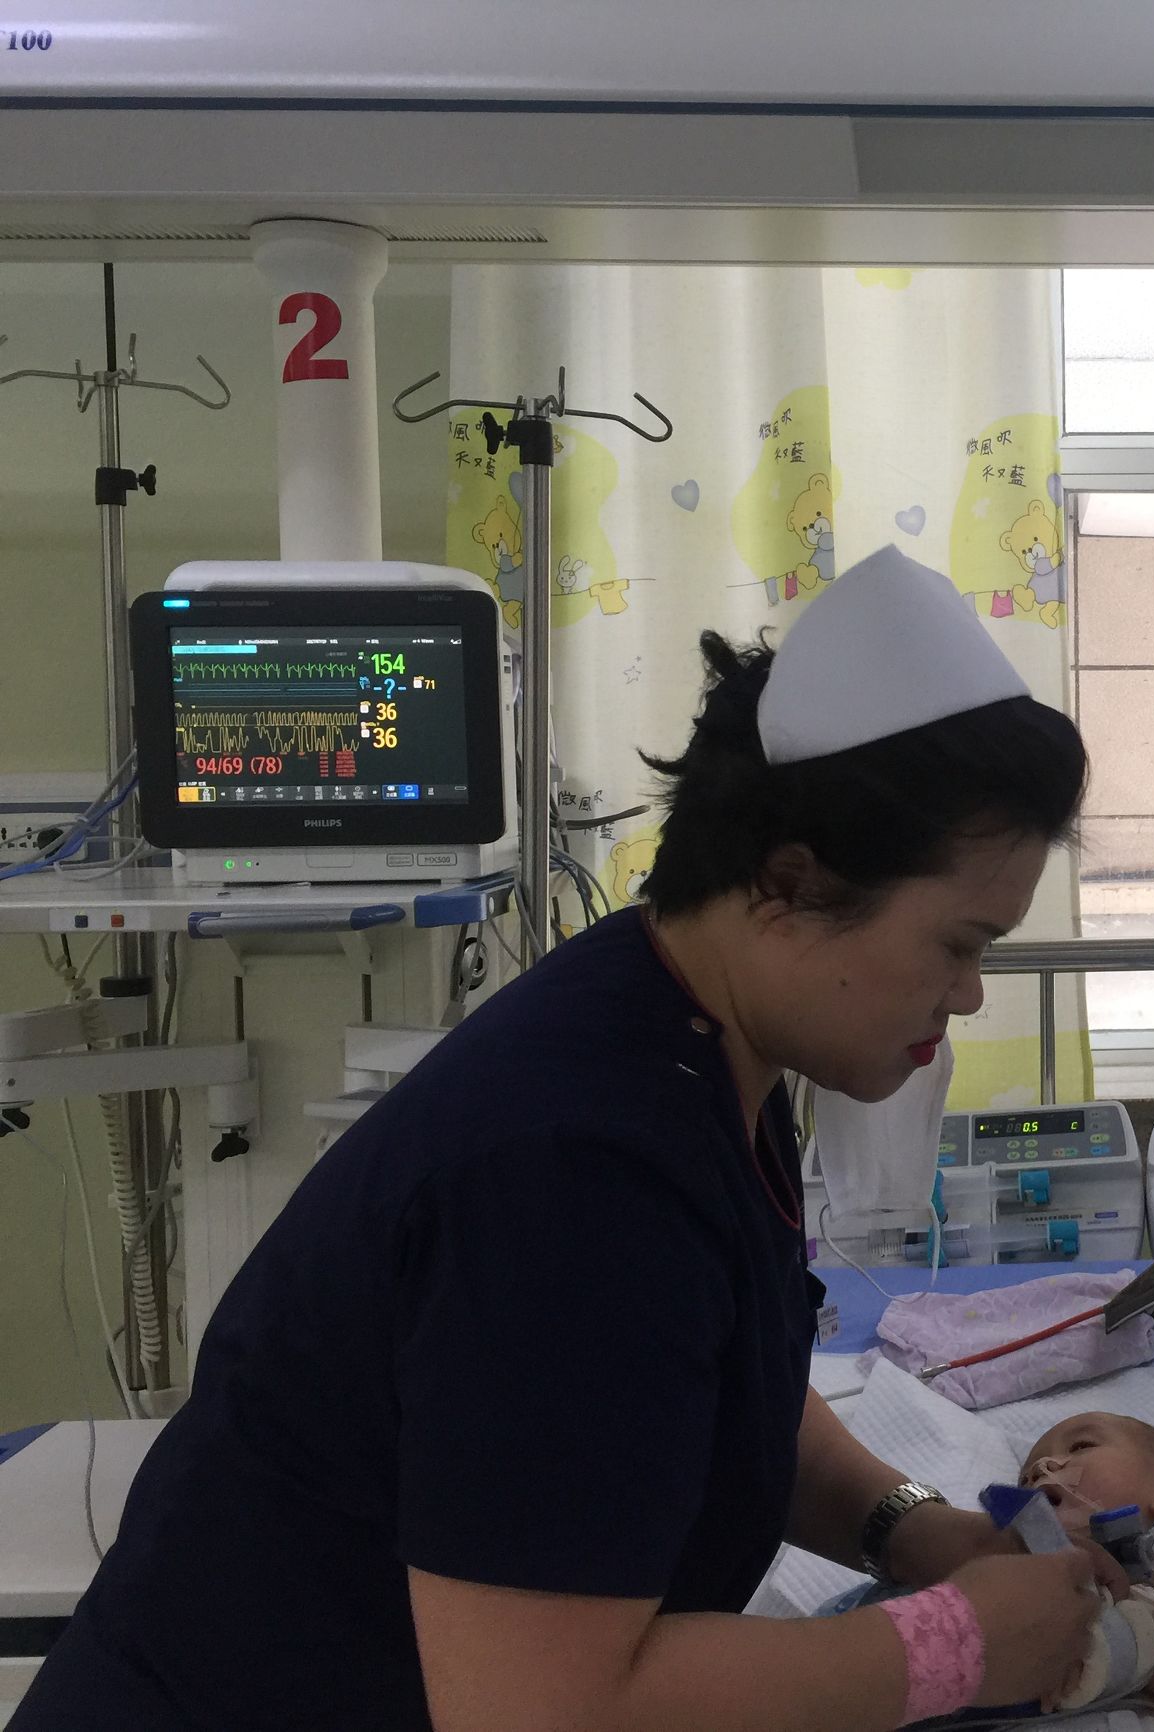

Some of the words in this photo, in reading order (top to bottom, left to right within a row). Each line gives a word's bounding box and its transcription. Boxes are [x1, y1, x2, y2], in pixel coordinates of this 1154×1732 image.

[0, 29, 52, 51] 100
[278, 292, 349, 384] 2
[371, 653, 406, 675] 154
[424, 680, 436, 690] 71
[376, 702, 398, 721] 36
[372, 727, 398, 749] 36
[196, 756, 244, 775] 94/69
[250, 756, 283, 775] (78)
[304, 818, 342, 828] PHILIPS
[1022, 1121, 1038, 1133] 0.5
